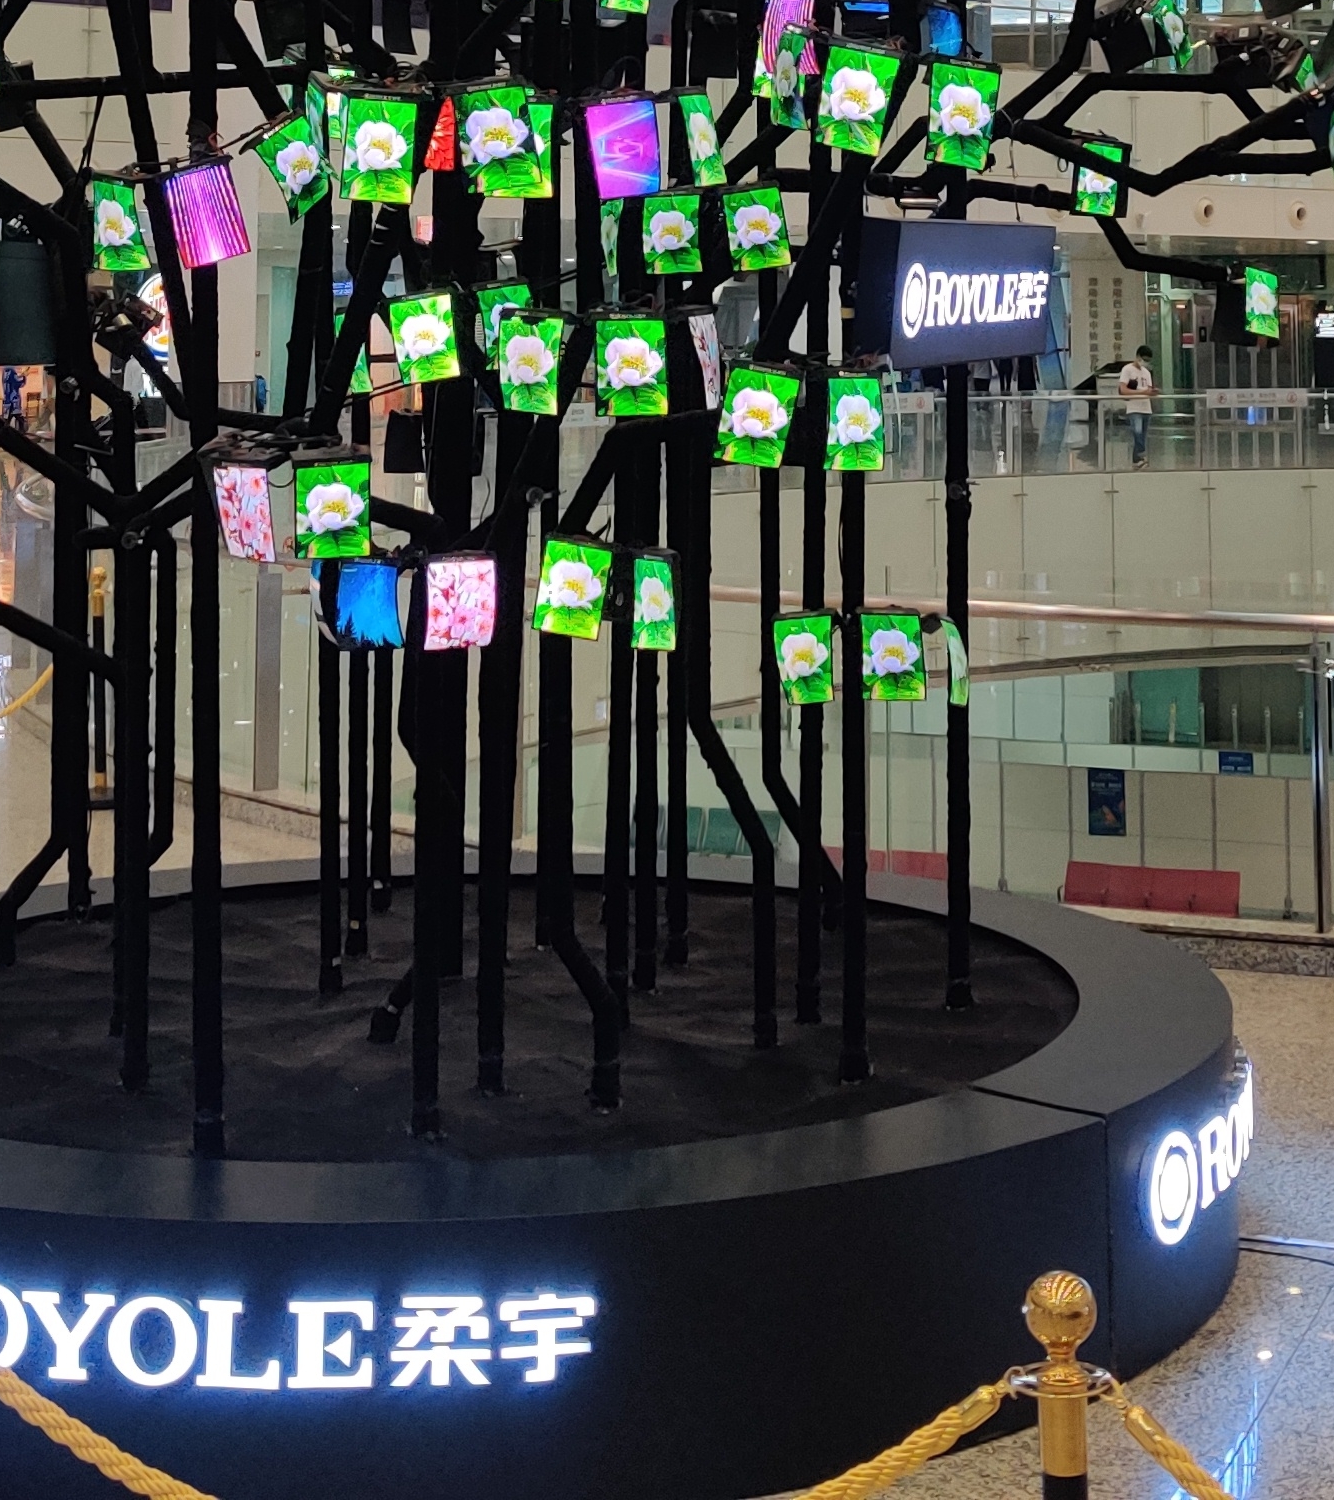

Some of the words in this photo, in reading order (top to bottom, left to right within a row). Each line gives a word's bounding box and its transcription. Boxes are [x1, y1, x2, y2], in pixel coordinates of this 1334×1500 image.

[924, 271, 1018, 327] ROYOLE
[1016, 270, 1049, 319] 柔宇
[390, 1293, 598, 1388] 柔宇
